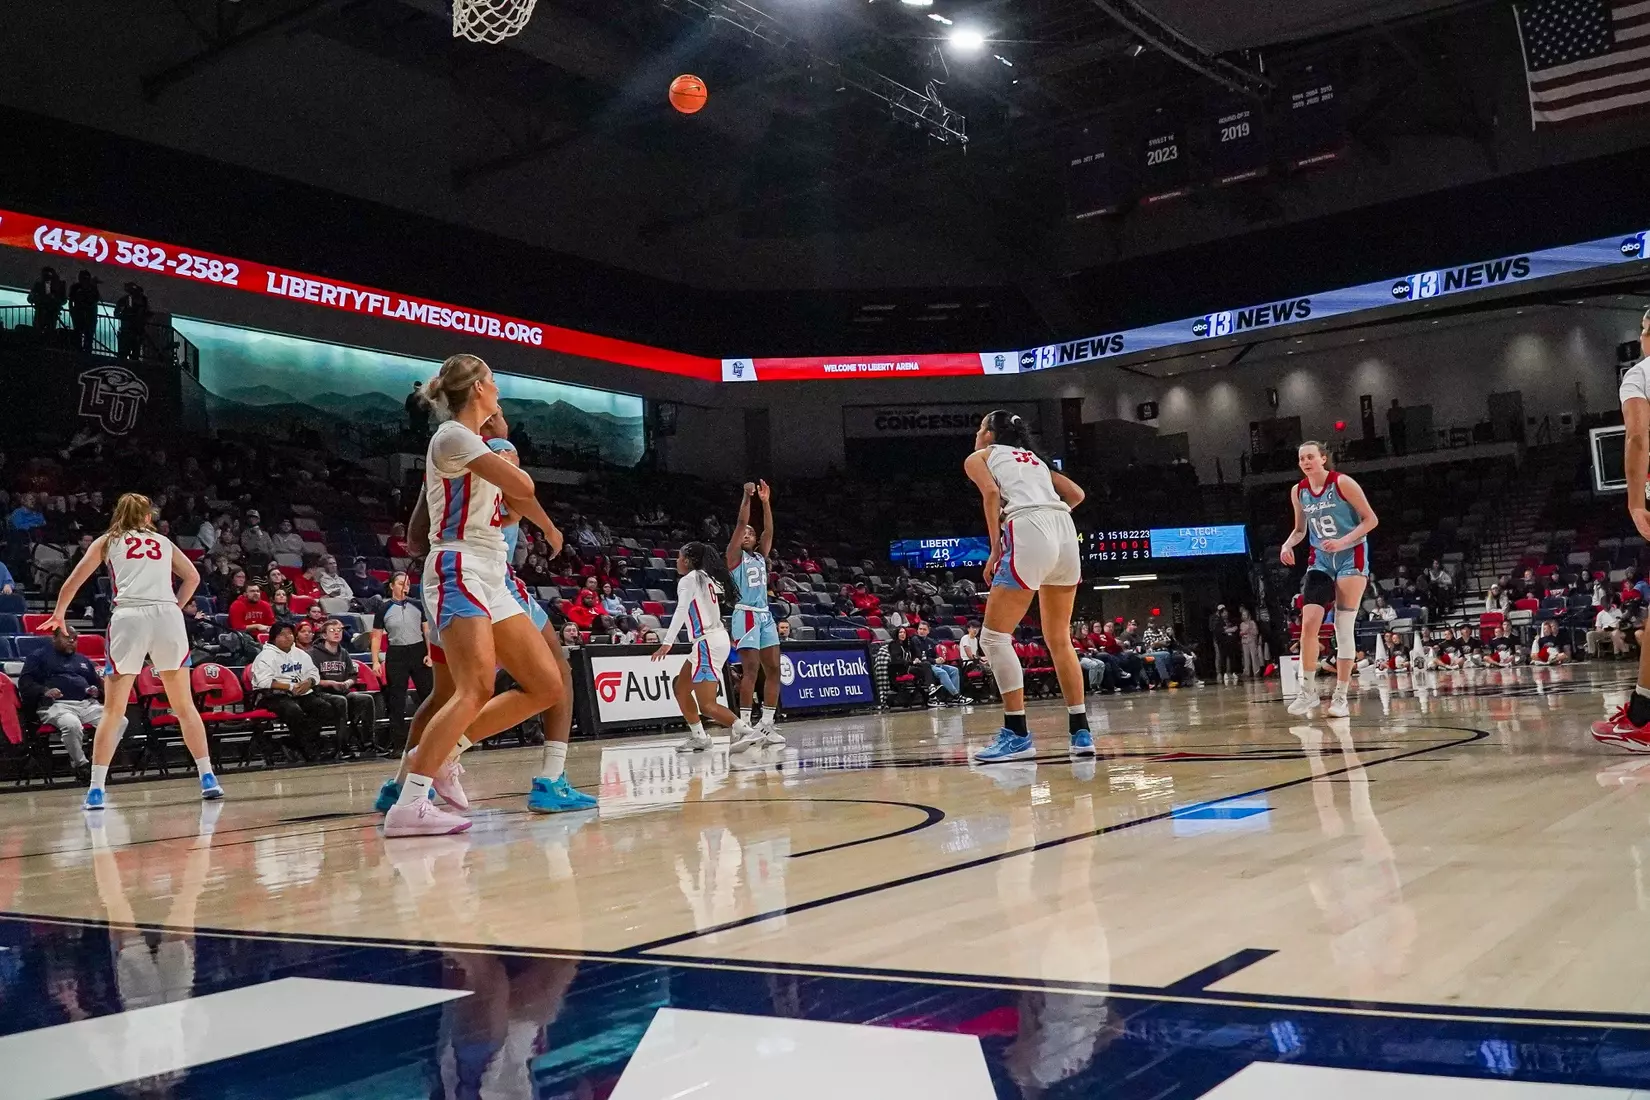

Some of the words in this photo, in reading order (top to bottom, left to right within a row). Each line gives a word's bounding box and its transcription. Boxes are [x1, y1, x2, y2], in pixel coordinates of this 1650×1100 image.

[1221, 122, 1250, 142] 2019
[1147, 145, 1178, 166] 2023
[1621, 243, 1640, 252] abc
[34, 225, 109, 262] (434)
[115, 240, 239, 285] 582-2582
[266, 271, 543, 345] LIBERTYFLAMESCLUB.ORG
[1392, 284, 1410, 294] abc
[1410, 272, 1438, 300] 13
[1443, 256, 1530, 291] NEWS
[1192, 324, 1207, 332] abc
[1208, 312, 1232, 337] 13
[1236, 298, 1311, 330] NEWS
[1035, 345, 1055, 369] 13
[1059, 334, 1124, 362] NEWS
[823, 363, 857, 372] WELCOME
[857, 363, 867, 372] TO
[867, 362, 894, 372] LIBERTY
[895, 361, 920, 371] ARENA
[1098, 531, 1105, 540] 3
[1108, 531, 1118, 540] 15
[1119, 530, 1129, 539] 18
[1129, 530, 1140, 539] 22
[1140, 529, 1150, 538] 23
[1194, 527, 1217, 536] TECH
[1311, 514, 1337, 539] 18
[125, 537, 162, 560] 23
[920, 538, 960, 549] LIBERTY
[1099, 542, 1105, 551] 2
[1191, 536, 1208, 550] 29
[932, 548, 951, 561] 48
[1098, 552, 1109, 561] 15
[1110, 551, 1116, 560] 2
[1121, 551, 1128, 560] 2
[1132, 550, 1139, 559] 5
[1143, 550, 1150, 558] 3
[797, 659, 835, 678] Carter
[836, 656, 869, 676] Bank
[625, 670, 680, 702] Aut
[799, 688, 815, 699] LIFE
[819, 686, 841, 698] LIVED
[844, 685, 864, 696] FULL
